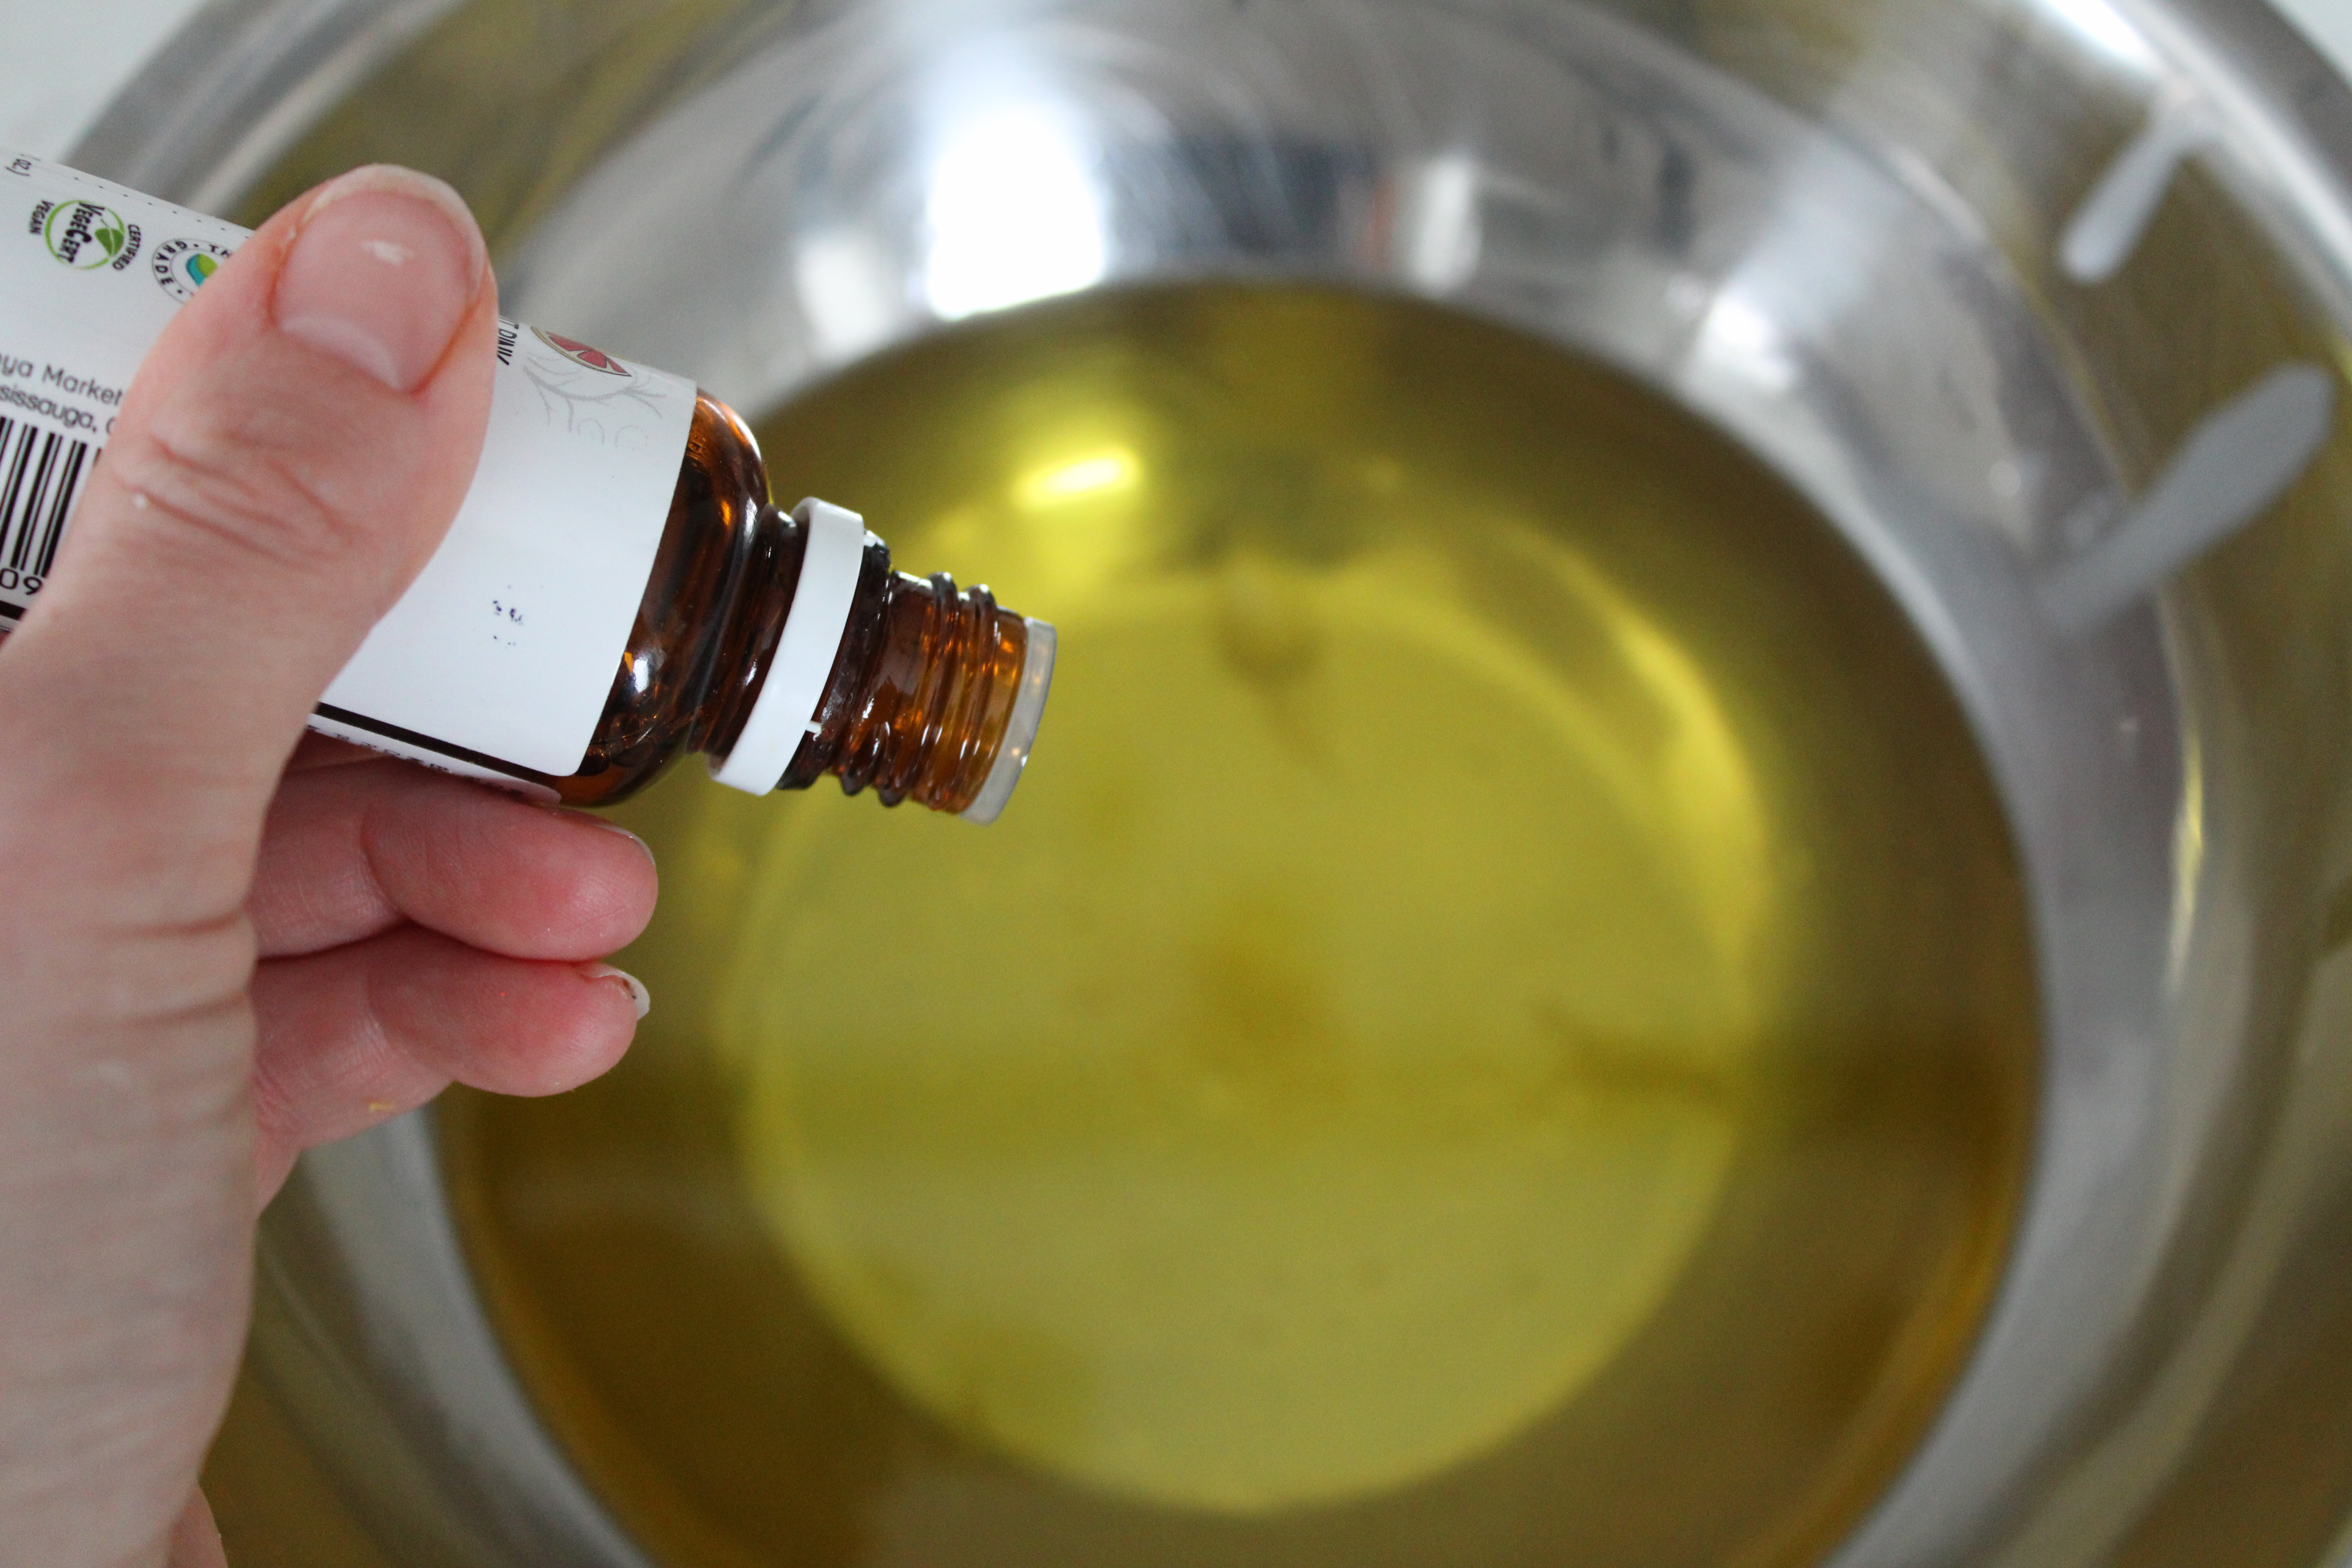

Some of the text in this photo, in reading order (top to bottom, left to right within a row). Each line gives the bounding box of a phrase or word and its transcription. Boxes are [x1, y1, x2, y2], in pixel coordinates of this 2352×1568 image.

[29, 200, 55, 235] VEGAN
[112, 224, 141, 271] CERTIFIED
[155, 240, 187, 285] GRADE
